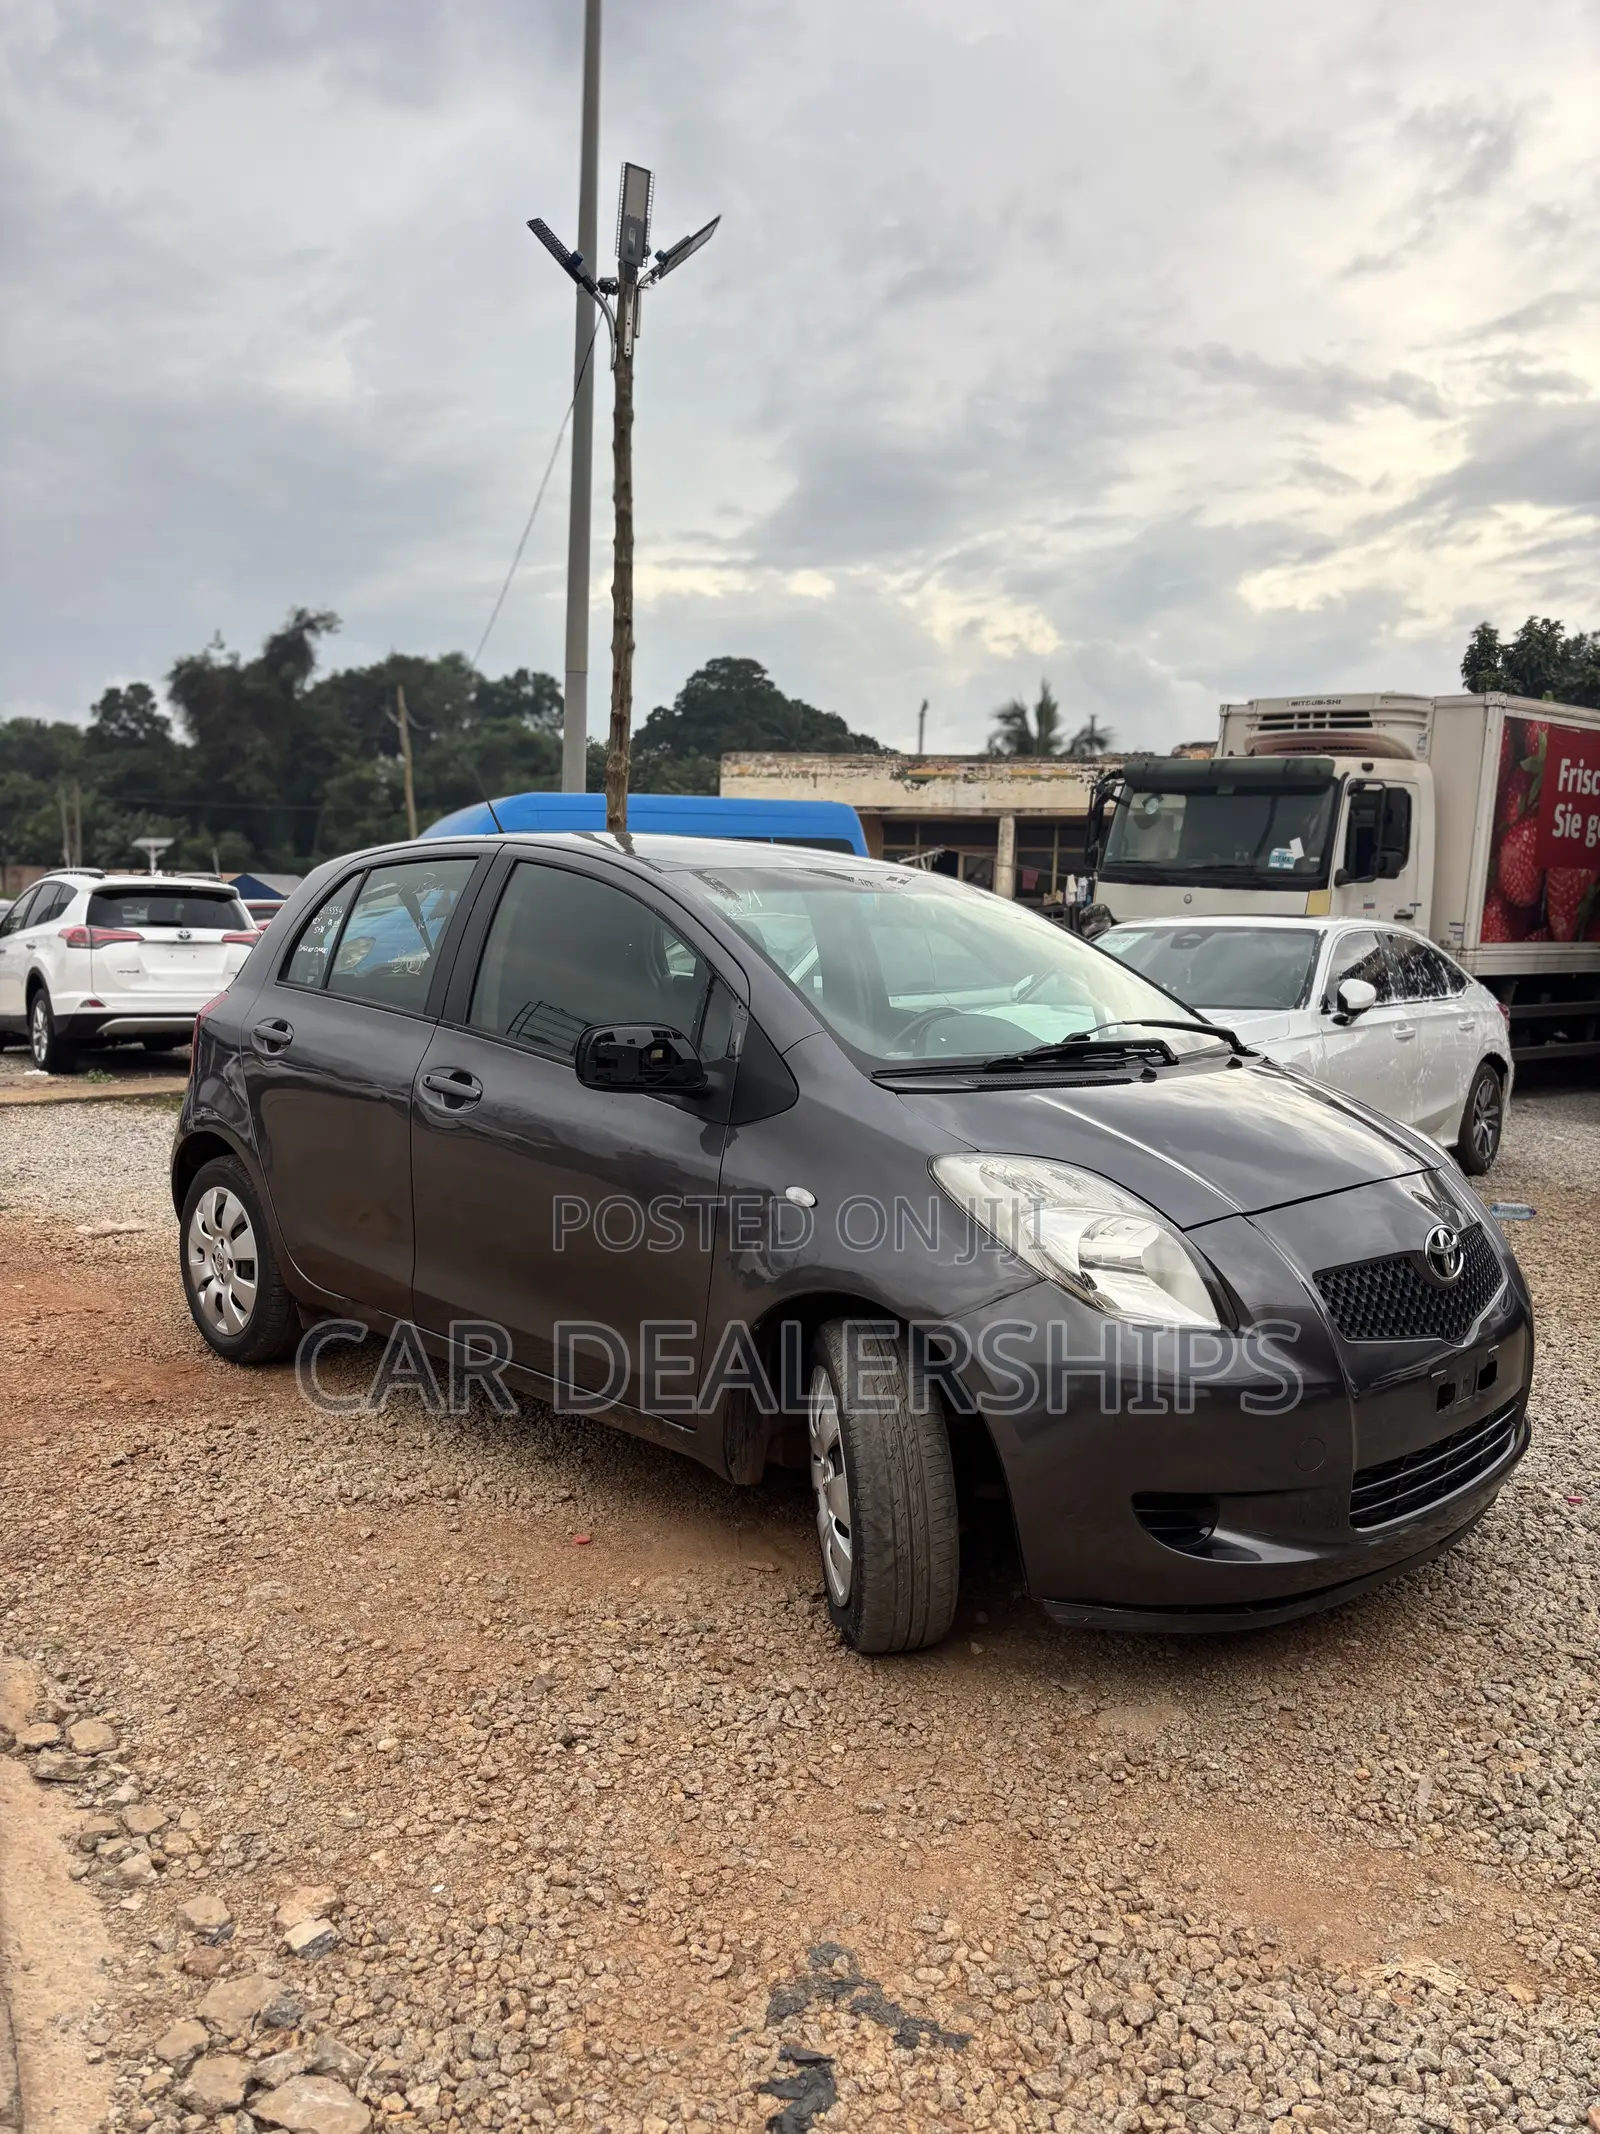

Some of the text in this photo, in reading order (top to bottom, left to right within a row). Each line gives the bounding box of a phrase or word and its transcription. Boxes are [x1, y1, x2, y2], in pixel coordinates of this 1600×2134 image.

[1290, 698, 1342, 707] MITSUBISHI
[1551, 803, 1600, 848] Sie g
